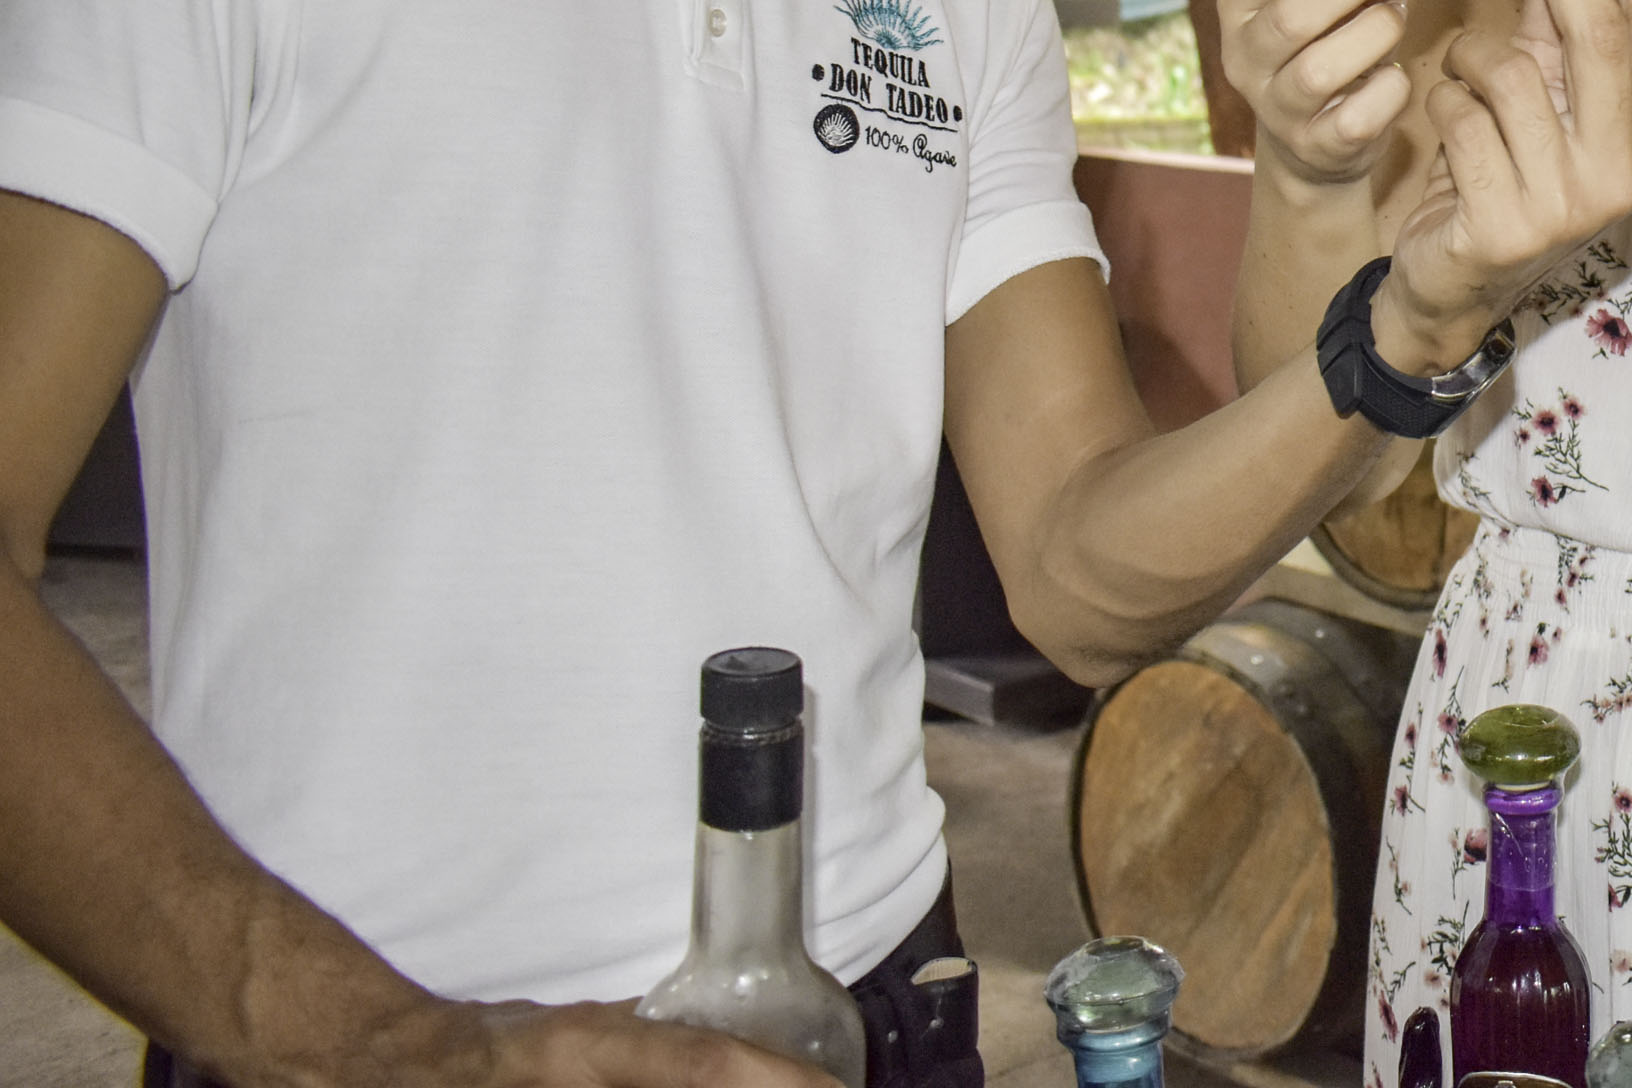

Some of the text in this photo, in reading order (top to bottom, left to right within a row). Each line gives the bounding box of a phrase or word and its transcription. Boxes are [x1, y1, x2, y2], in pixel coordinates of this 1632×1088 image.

[851, 36, 931, 89] TEQUILA
[828, 63, 949, 124] DON TADEO
[864, 125, 957, 174] 100% Agave
